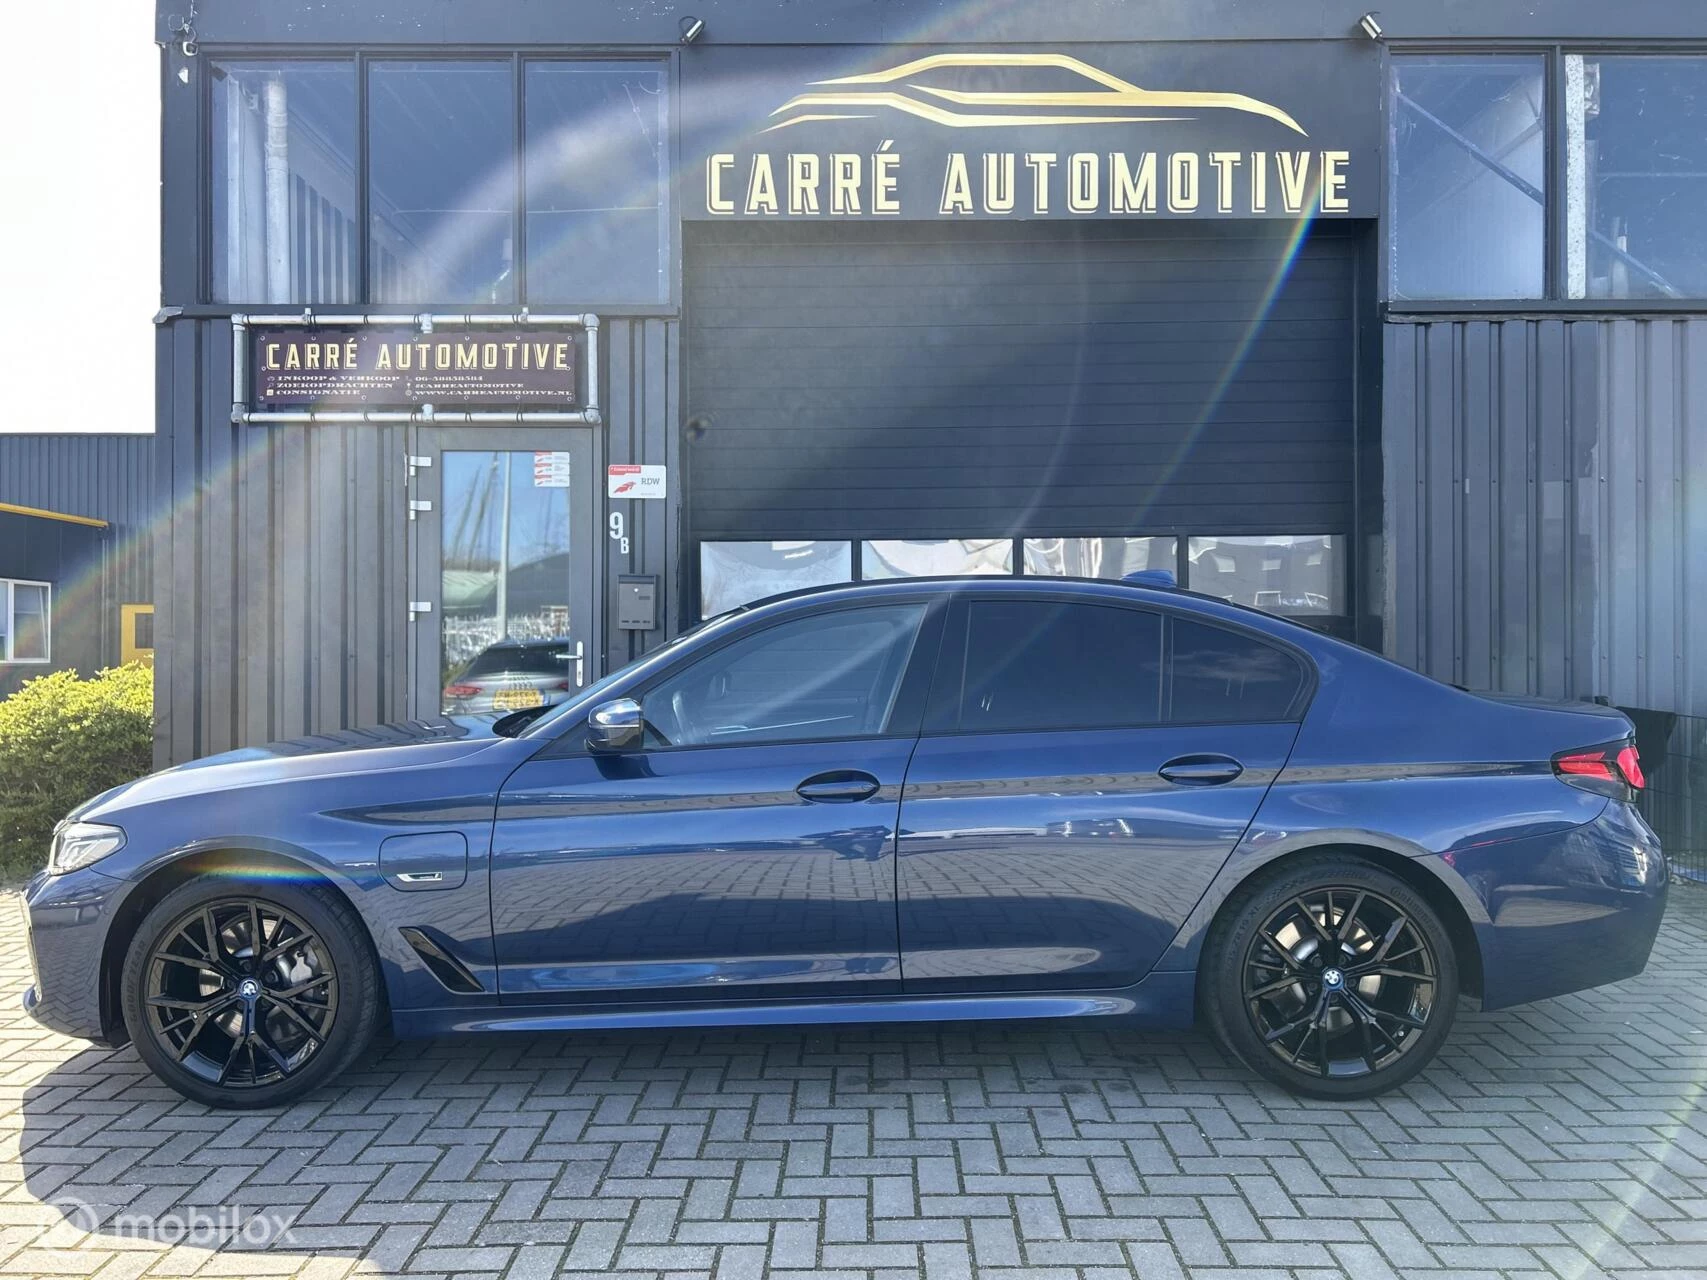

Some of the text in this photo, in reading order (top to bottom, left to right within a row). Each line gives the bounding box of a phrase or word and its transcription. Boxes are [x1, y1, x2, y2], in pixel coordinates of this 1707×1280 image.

[706, 140, 1351, 215] CARRÉ AUTOMOTIVE
[265, 338, 571, 371] CARRÉ AUTOMOTIVE
[641, 477, 660, 485] RDW
